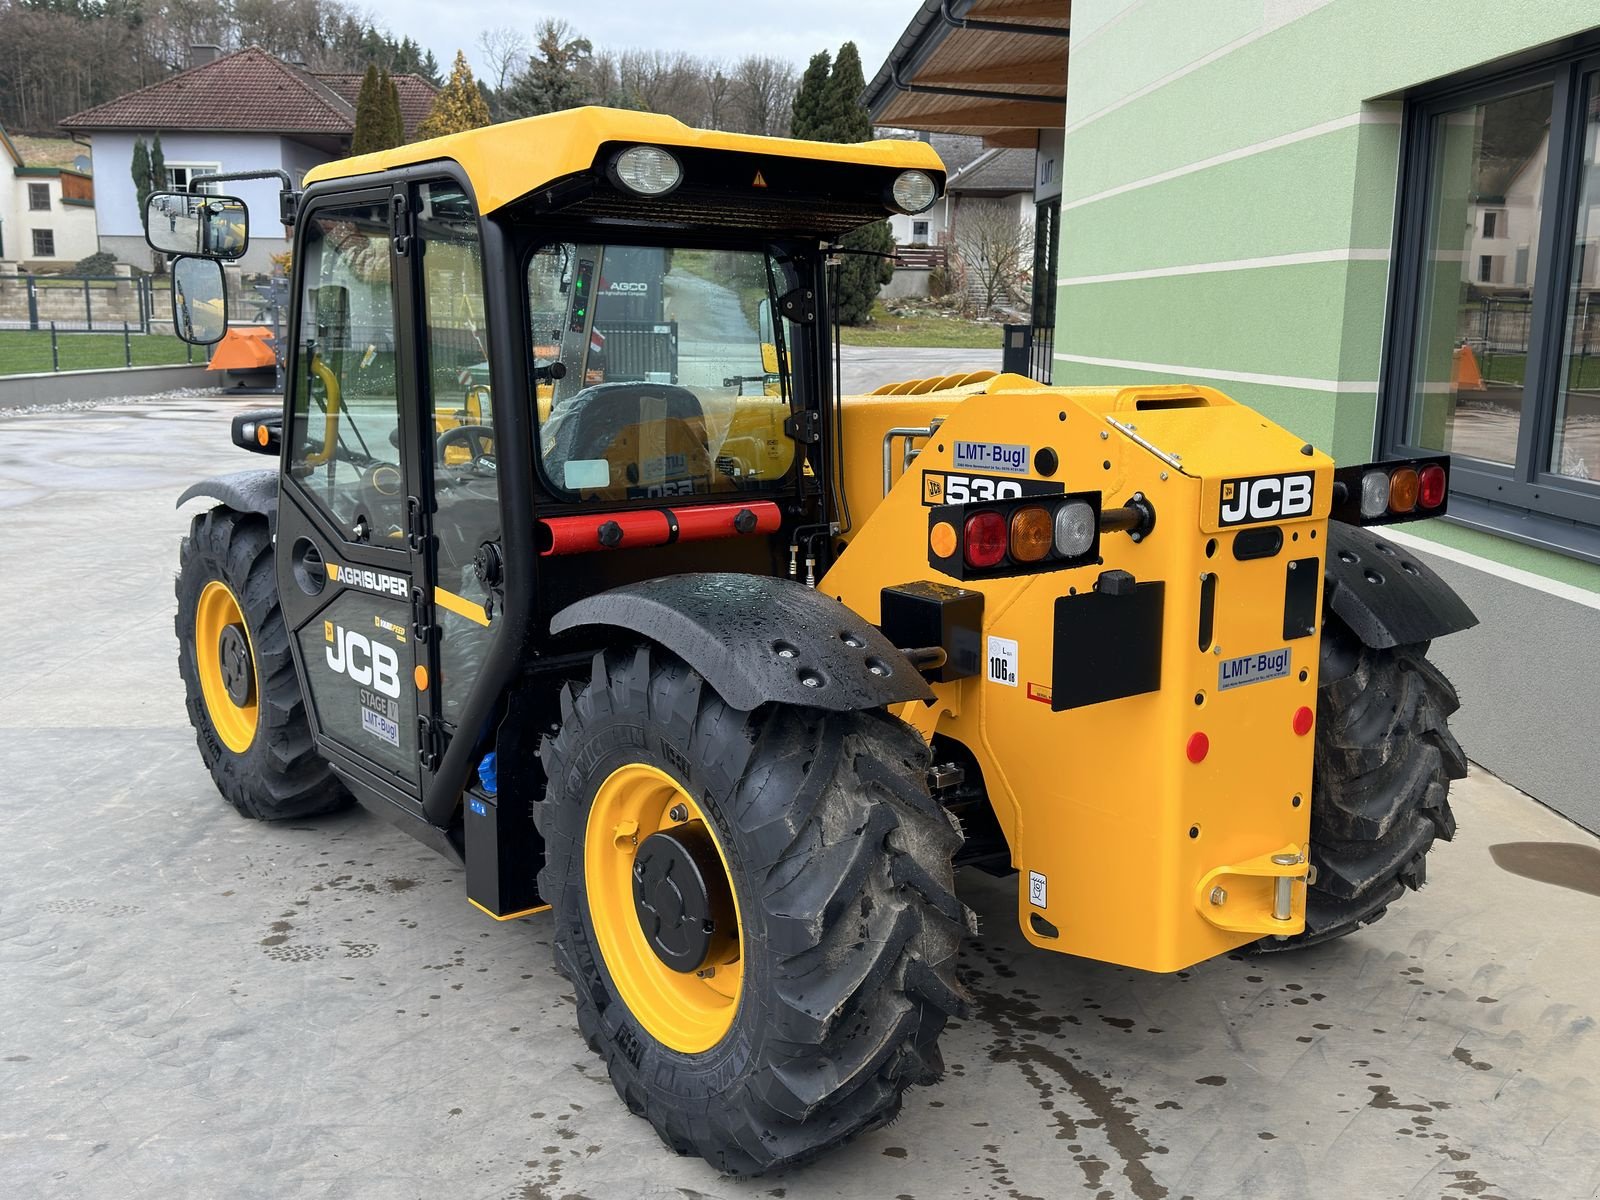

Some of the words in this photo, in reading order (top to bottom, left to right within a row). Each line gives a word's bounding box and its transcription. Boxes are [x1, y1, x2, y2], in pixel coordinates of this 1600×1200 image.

[1040, 159, 1054, 185] LMT
[610, 282, 648, 291] AGCO
[957, 443, 1025, 468] LMT-Bugl
[946, 476, 1022, 504] 530
[1221, 475, 1312, 523] JCB
[337, 566, 408, 598] AGRISUPER
[326, 624, 400, 699] JCB
[990, 656, 1008, 681] 106
[1223, 650, 1287, 679] LMT-Bugl
[360, 688, 387, 714] STAGE
[364, 709, 397, 739] LMT-Bugl
